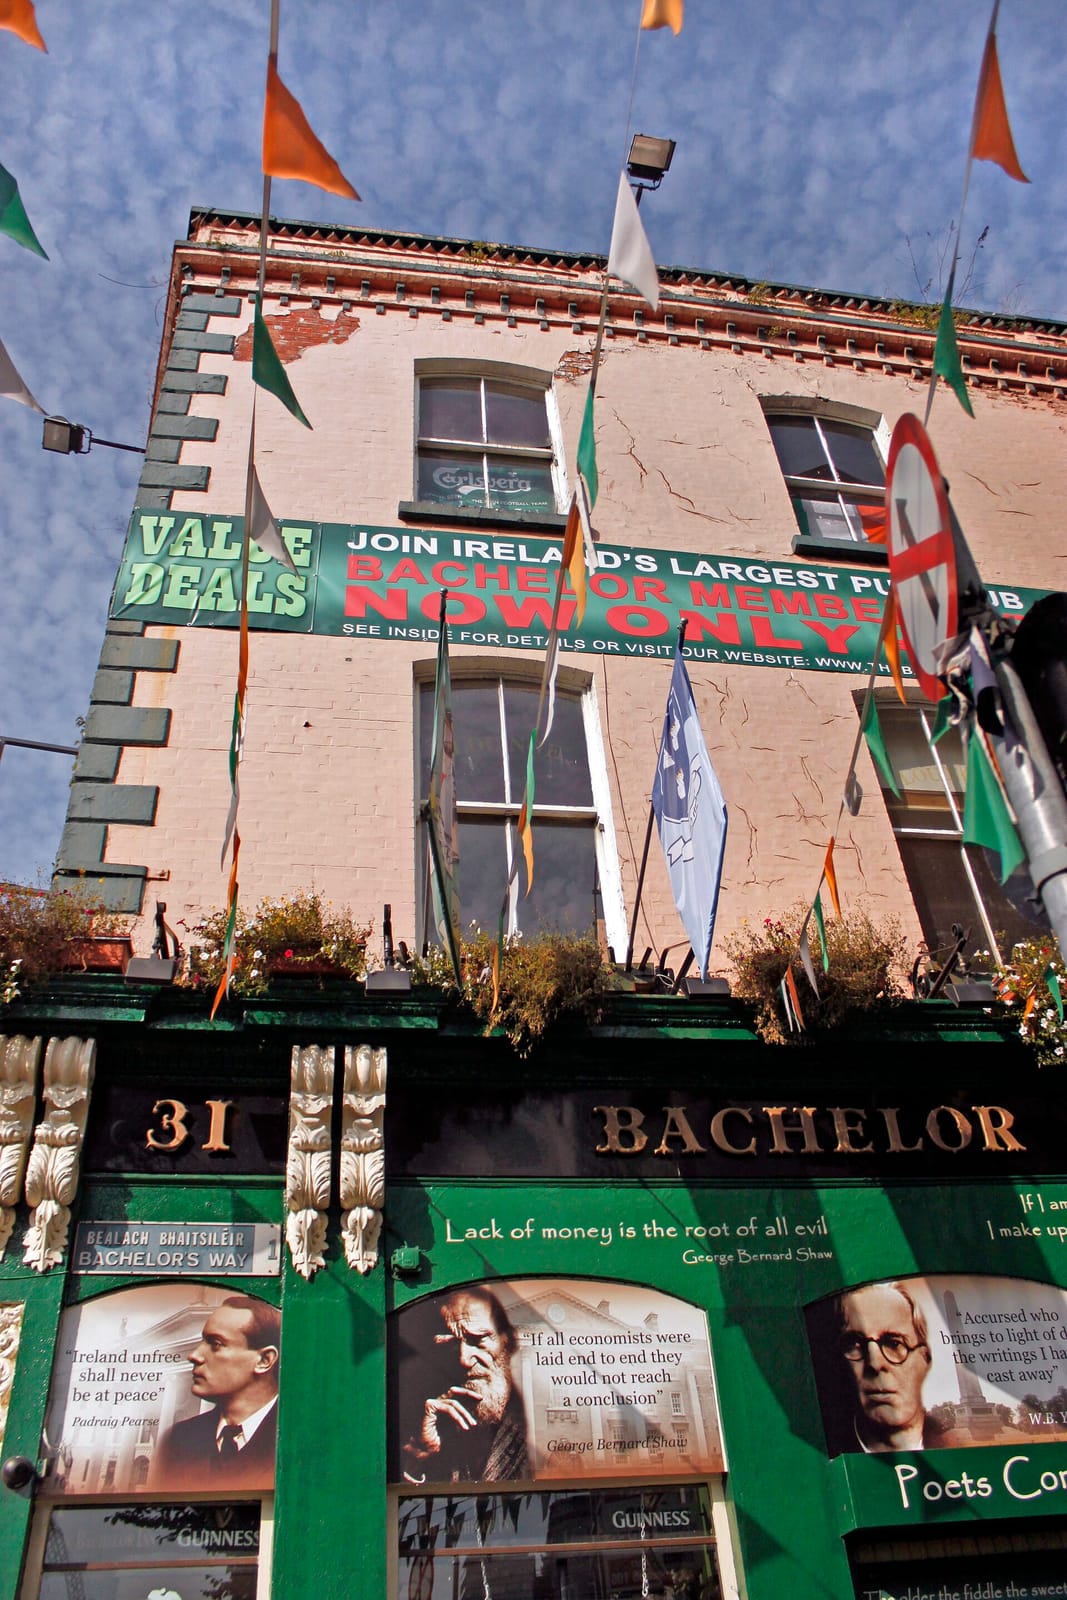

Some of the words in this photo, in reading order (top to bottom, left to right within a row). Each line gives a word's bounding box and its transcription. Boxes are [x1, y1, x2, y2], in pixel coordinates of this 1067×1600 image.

[347, 532, 438, 555] JOIN
[453, 539, 658, 573] IRELAD'S
[670, 558, 838, 590] LARGEST
[347, 554, 672, 603] BACHELOR
[124, 563, 307, 618] DEALS
[344, 584, 578, 631] NOW
[606, 604, 860, 655] ONLY
[342, 623, 381, 635] SEE
[460, 631, 500, 644] FOR
[593, 639, 620, 651] OR
[625, 642, 673, 656] VISIT
[681, 646, 719, 659] OUR
[725, 650, 810, 666] WEBSITE:
[145, 1099, 233, 1152] 31
[592, 1104, 1027, 1155] BACHELOR
[1019, 1193, 1034, 1214] If
[87, 1231, 149, 1246] BEALACH
[159, 1228, 245, 1247] BHAITSILÉIR
[446, 1218, 504, 1243] Lack
[510, 1218, 535, 1240] of
[541, 1227, 613, 1246] money
[619, 1222, 637, 1239] is
[643, 1219, 678, 1238] the
[684, 1223, 730, 1238] root
[736, 1216, 758, 1237] of
[765, 1216, 788, 1236] all
[794, 1215, 829, 1236] evil
[1000, 1221, 1042, 1237] make
[1046, 1226, 1067, 1243] up
[79, 1251, 200, 1268] BACHELOR'S
[209, 1252, 248, 1268] WAY
[682, 1249, 734, 1266] George
[736, 1248, 792, 1264] Bernard
[796, 1247, 833, 1262] Shaw
[1029, 1307, 1060, 1322] who
[546, 1331, 565, 1346] all
[569, 1330, 653, 1346] economists
[656, 1332, 692, 1344] were
[940, 1330, 986, 1349] brings
[989, 1329, 1005, 1343] to
[1006, 1326, 1040, 1346] light
[1042, 1326, 1056, 1341] of
[132, 1349, 182, 1364] unfree
[536, 1351, 564, 1366] laid
[568, 1351, 596, 1366] end
[600, 1352, 616, 1365] to
[619, 1350, 647, 1365] end
[651, 1349, 683, 1366] they
[953, 1350, 976, 1365] the
[979, 1347, 1038, 1365] writings
[1039, 1346, 1047, 1361] I
[78, 1367, 116, 1382] shall
[119, 1371, 163, 1382] never
[551, 1371, 598, 1386] would
[602, 1371, 627, 1385] not
[631, 1369, 673, 1384] reach
[986, 1369, 1016, 1383] cast
[72, 1387, 91, 1402] be
[94, 1388, 110, 1402] at
[563, 1397, 572, 1407] a
[72, 1415, 119, 1430] Padraig
[121, 1416, 160, 1428] Pearse
[547, 1439, 594, 1453] George
[596, 1437, 649, 1451] Bernard
[650, 1436, 688, 1450] Shaw
[894, 1464, 993, 1510] Poets
[612, 1510, 691, 1529] GUINNESS
[938, 1584, 960, 1600] the
[963, 1581, 1003, 1600] fiddle
[1005, 1580, 1028, 1598] the
